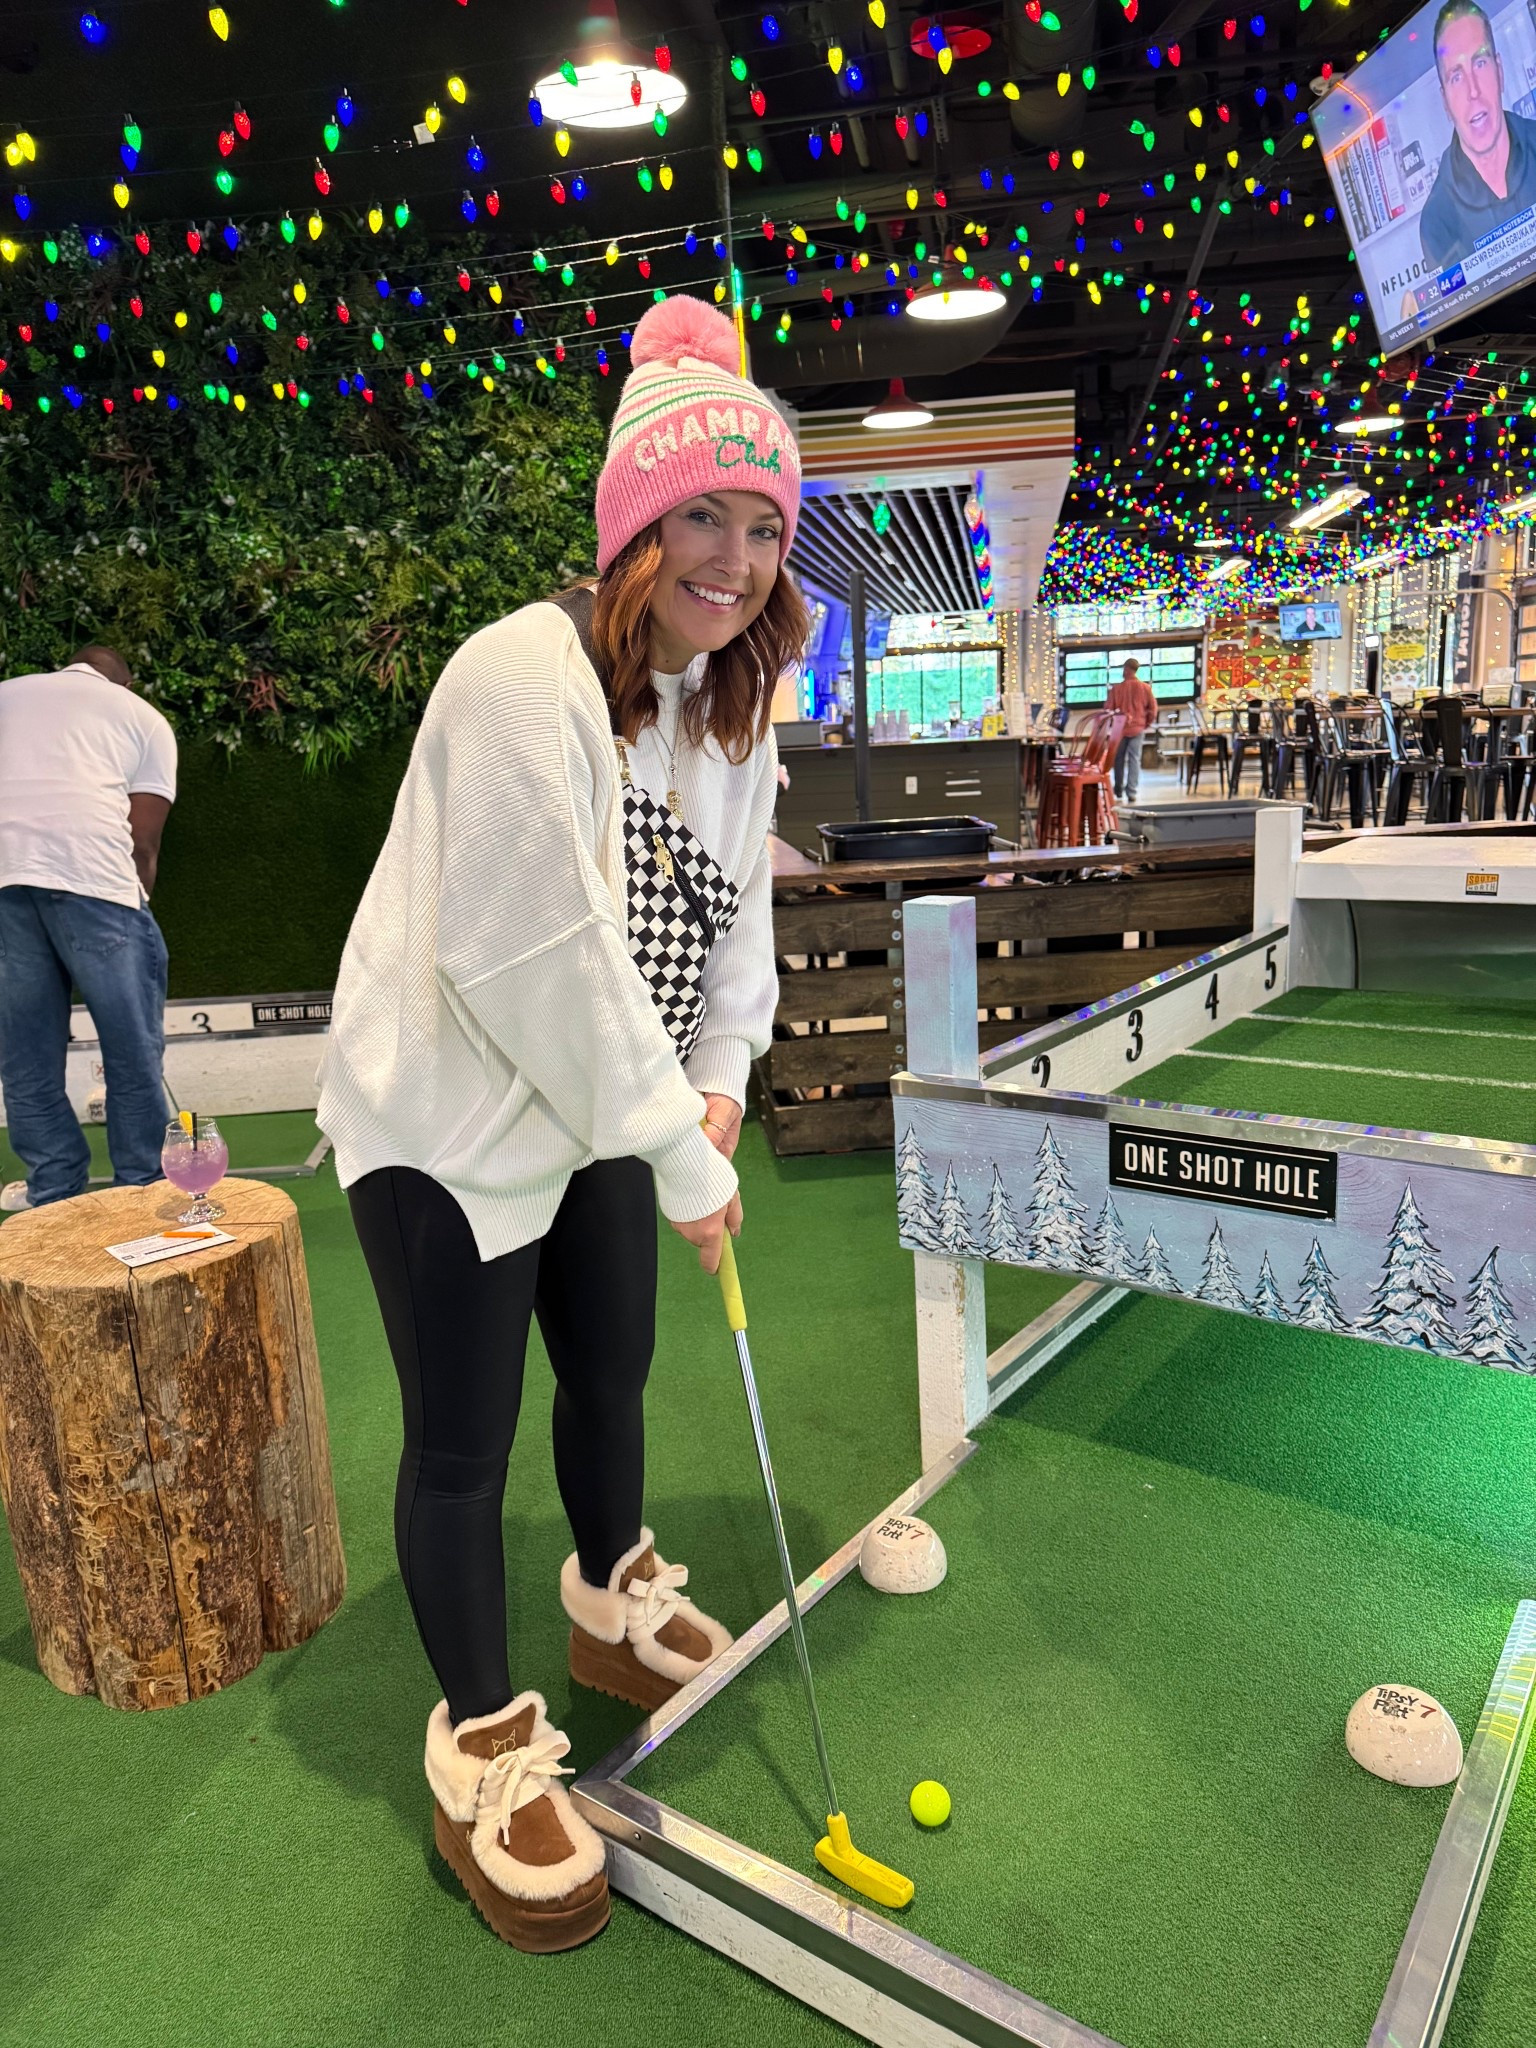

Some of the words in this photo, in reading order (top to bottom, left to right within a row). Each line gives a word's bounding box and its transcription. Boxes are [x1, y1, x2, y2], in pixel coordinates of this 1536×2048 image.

[1475, 236, 1493, 249] EMPTY
[1492, 228, 1504, 239] THE
[1502, 210, 1533, 233] NOTEBOOK
[1463, 255, 1480, 271] BUCS
[1477, 250, 1489, 264] WR
[1486, 240, 1507, 258] EMEKA
[1505, 226, 1530, 247] EGBUKA
[1428, 269, 1442, 280] FINAL
[1427, 286, 1439, 299] 32
[1440, 278, 1451, 291] 44
[1397, 325, 1410, 336] WEEK
[711, 434, 781, 474] Club
[1468, 875, 1497, 885] SOUTH
[1264, 944, 1277, 990] 5
[1204, 972, 1220, 1020] 4
[191, 1012, 212, 1033] 3
[257, 1008, 278, 1022] ONE
[278, 1006, 305, 1020] SHOT
[306, 1004, 331, 1019] HOLE
[1126, 1009, 1143, 1062] 3
[1124, 1142, 1169, 1177] ONE
[1178, 1150, 1245, 1188] SHOT
[1255, 1160, 1320, 1200] HOLE
[909, 1529, 925, 1540] 7
[1420, 1704, 1437, 1719] 7
